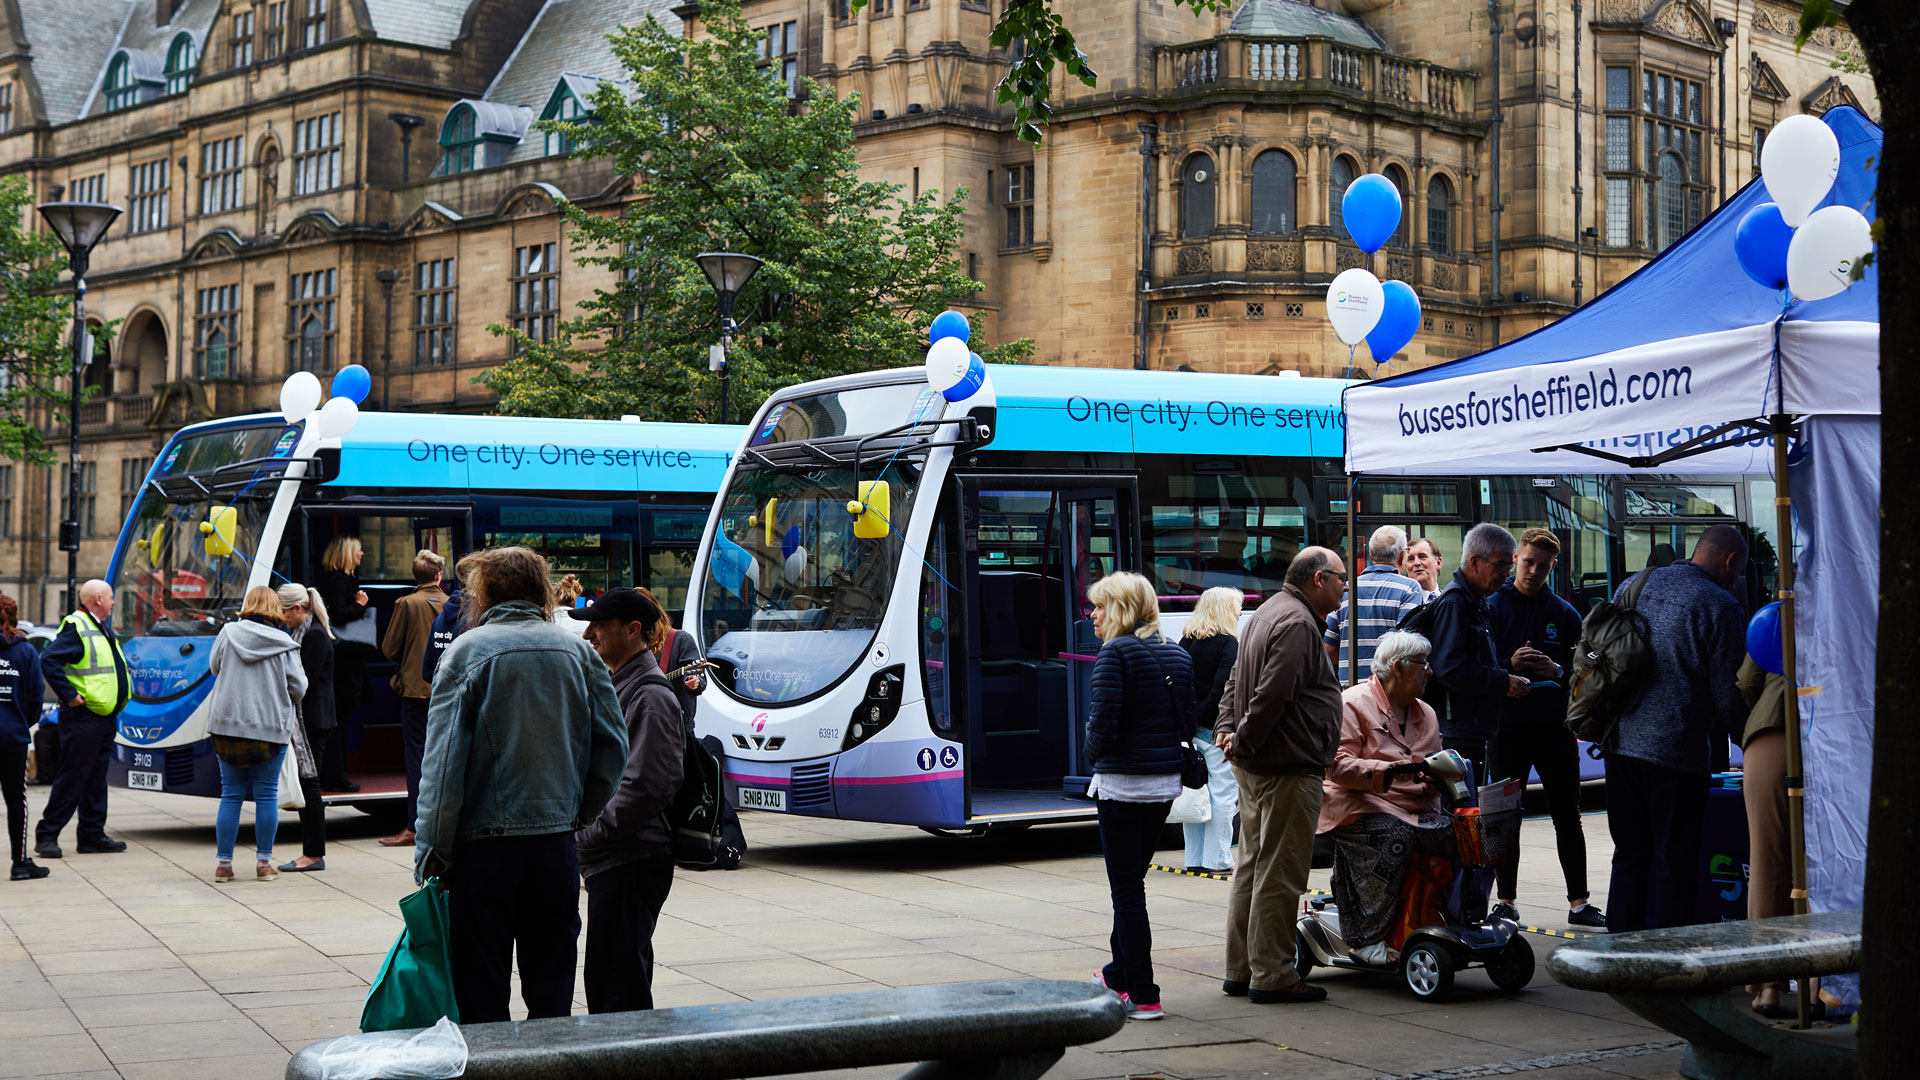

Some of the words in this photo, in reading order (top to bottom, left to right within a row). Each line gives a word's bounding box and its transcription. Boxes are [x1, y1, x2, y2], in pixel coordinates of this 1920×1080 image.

[1398, 365, 1692, 437] busesforsheffield.com
[1066, 395, 1130, 423] One
[1140, 396, 1198, 432] city.
[1206, 400, 1266, 427] One
[407, 438, 468, 463] One
[476, 440, 531, 470] city.
[539, 442, 595, 466] One
[602, 444, 698, 469] service.
[149, 667, 161, 678] One
[733, 667, 747, 680] One
[765, 669, 781, 681] One
[818, 728, 839, 739] 63912
[134, 753, 152, 767] 39103
[132, 773, 145, 786] SN18
[146, 774, 158, 787] XWP
[743, 789, 762, 806] SN18
[764, 791, 780, 808] XXU
